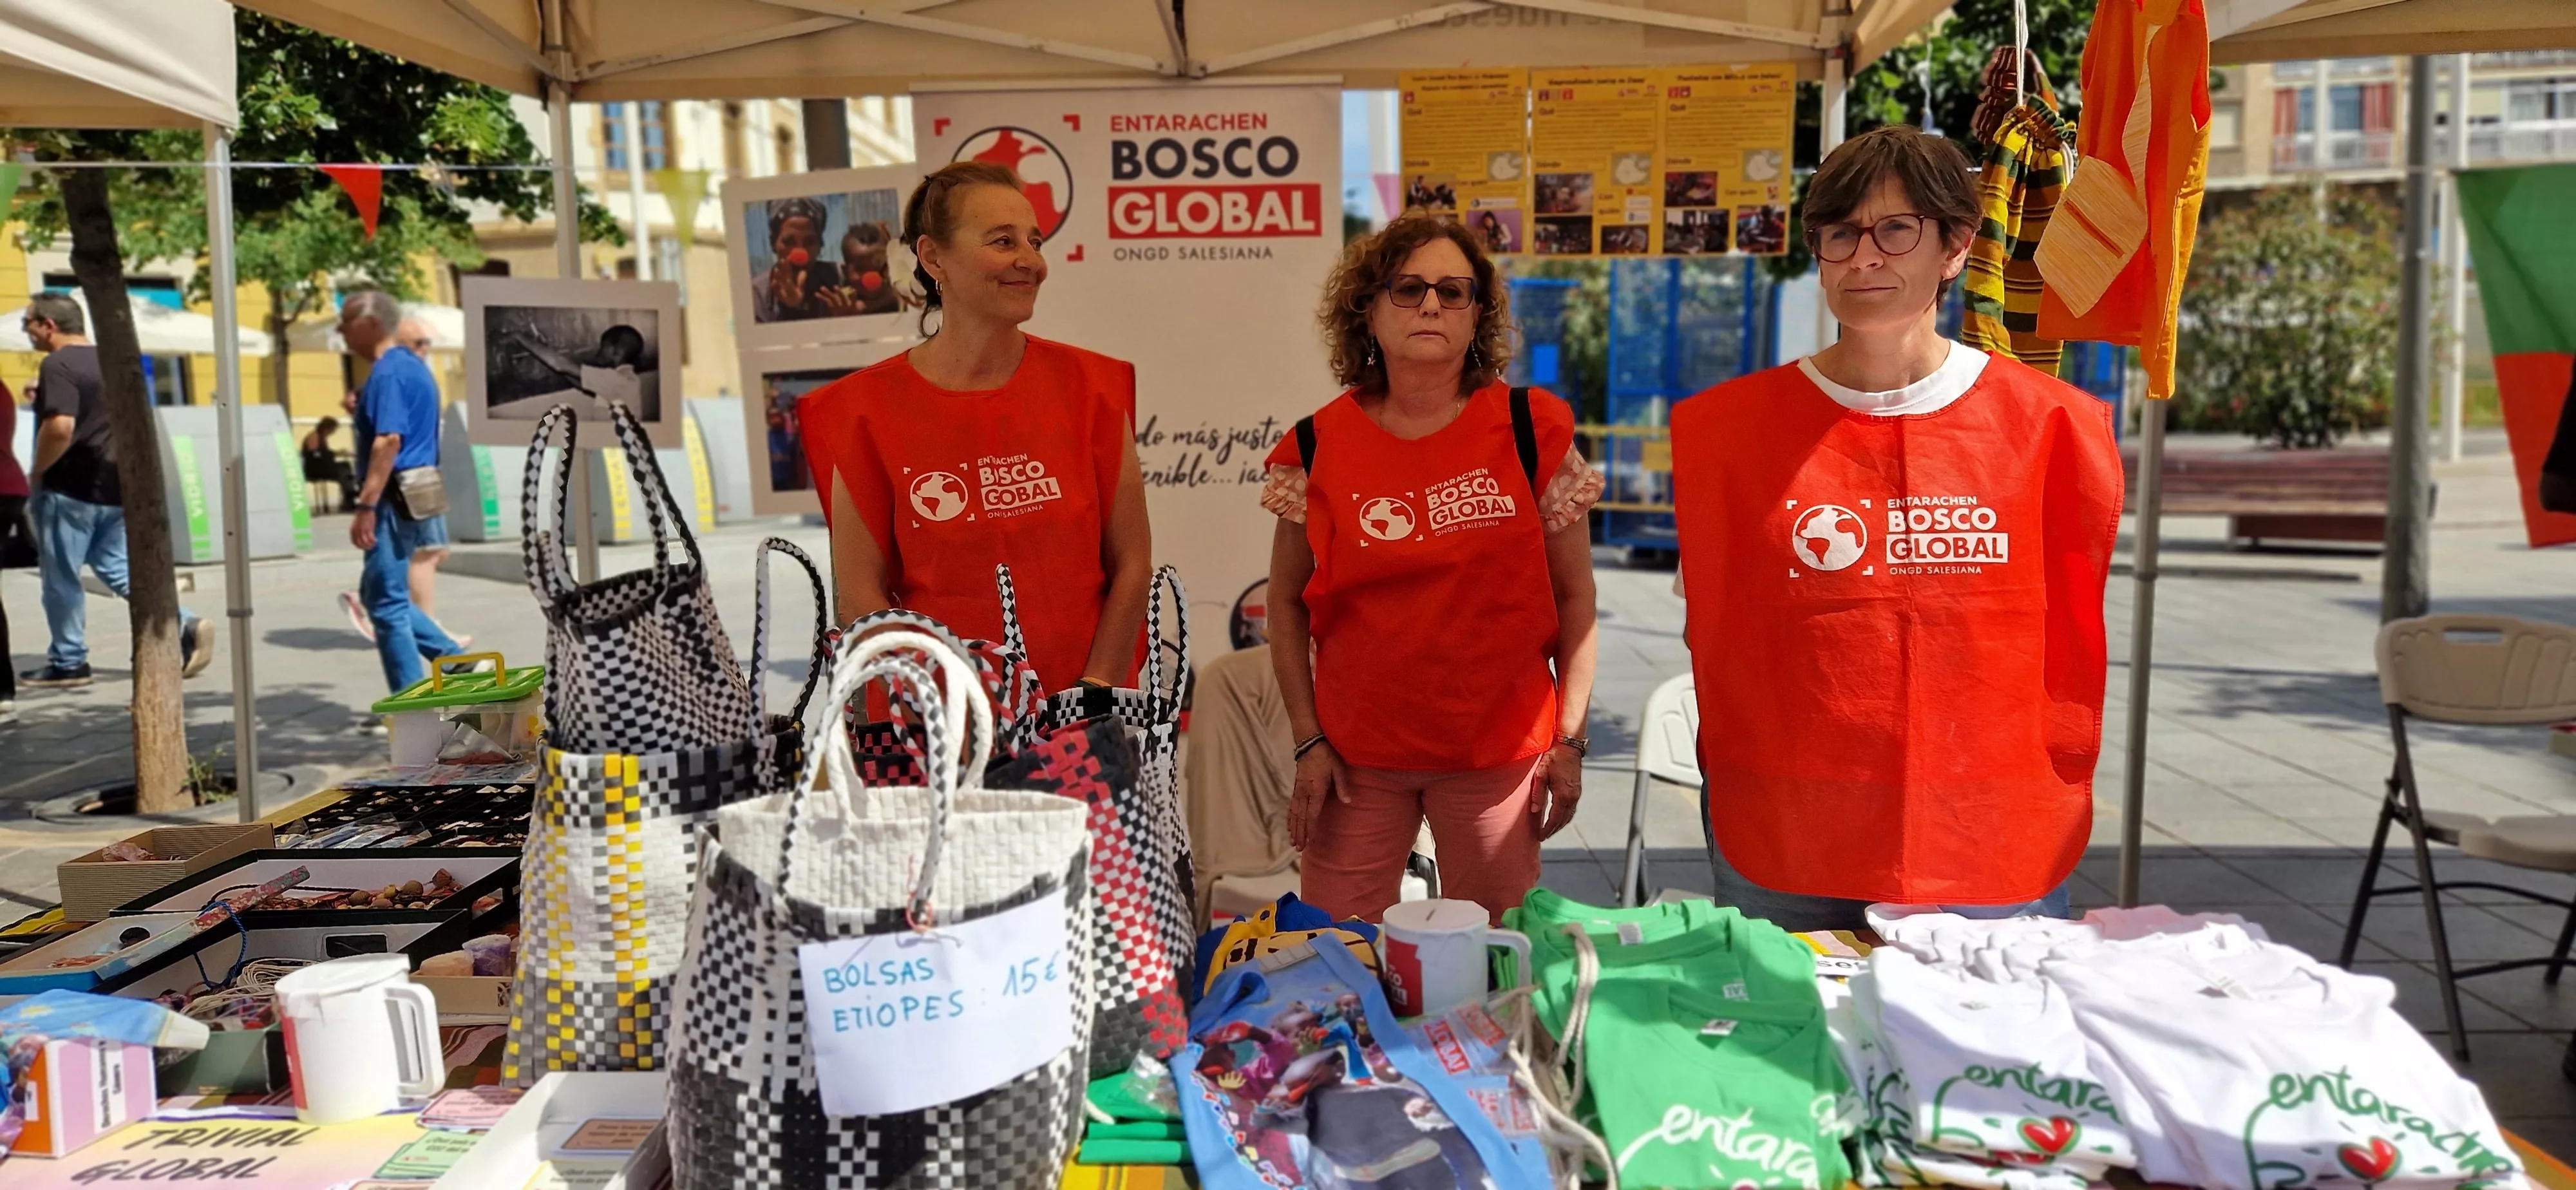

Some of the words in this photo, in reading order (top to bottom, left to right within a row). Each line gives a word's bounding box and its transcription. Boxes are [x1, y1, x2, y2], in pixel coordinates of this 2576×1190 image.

[1110, 113, 1268, 132] ENTARACHEN
[1111, 136, 1299, 180] BOSCO
[1112, 190, 1316, 234] GLOBAL
[1113, 247, 1170, 261] ONGD
[1178, 246, 1273, 261] SALESIANA
[1172, 420, 1221, 451] más
[179, 452, 204, 519] VIDRIO
[280, 449, 305, 513] VIDRIO
[1425, 468, 1489, 495] ENTARACHEN
[1426, 477, 1499, 509] BOSCO
[1431, 497, 1513, 525] GLOBAL
[1887, 496, 1978, 509] ENTARACHEN
[1435, 525, 1459, 536] ONGD
[1461, 520, 1500, 530] SALESIANA
[1888, 507, 1997, 533] BOSCO
[1889, 537, 2003, 560] GLOBAL
[1889, 566, 1922, 575] ONGD
[1927, 565, 1982, 574] SALESIANA
[822, 958, 934, 994] BOLSAS
[832, 989, 965, 1033] ETIOPES
[1002, 949, 1061, 998] 15€
[1963, 1061, 2125, 1126] entara
[122, 1126, 321, 1149] TRIVIAL
[1660, 1103, 1821, 1190] entara
[71, 1155, 278, 1186] GLOBAL
